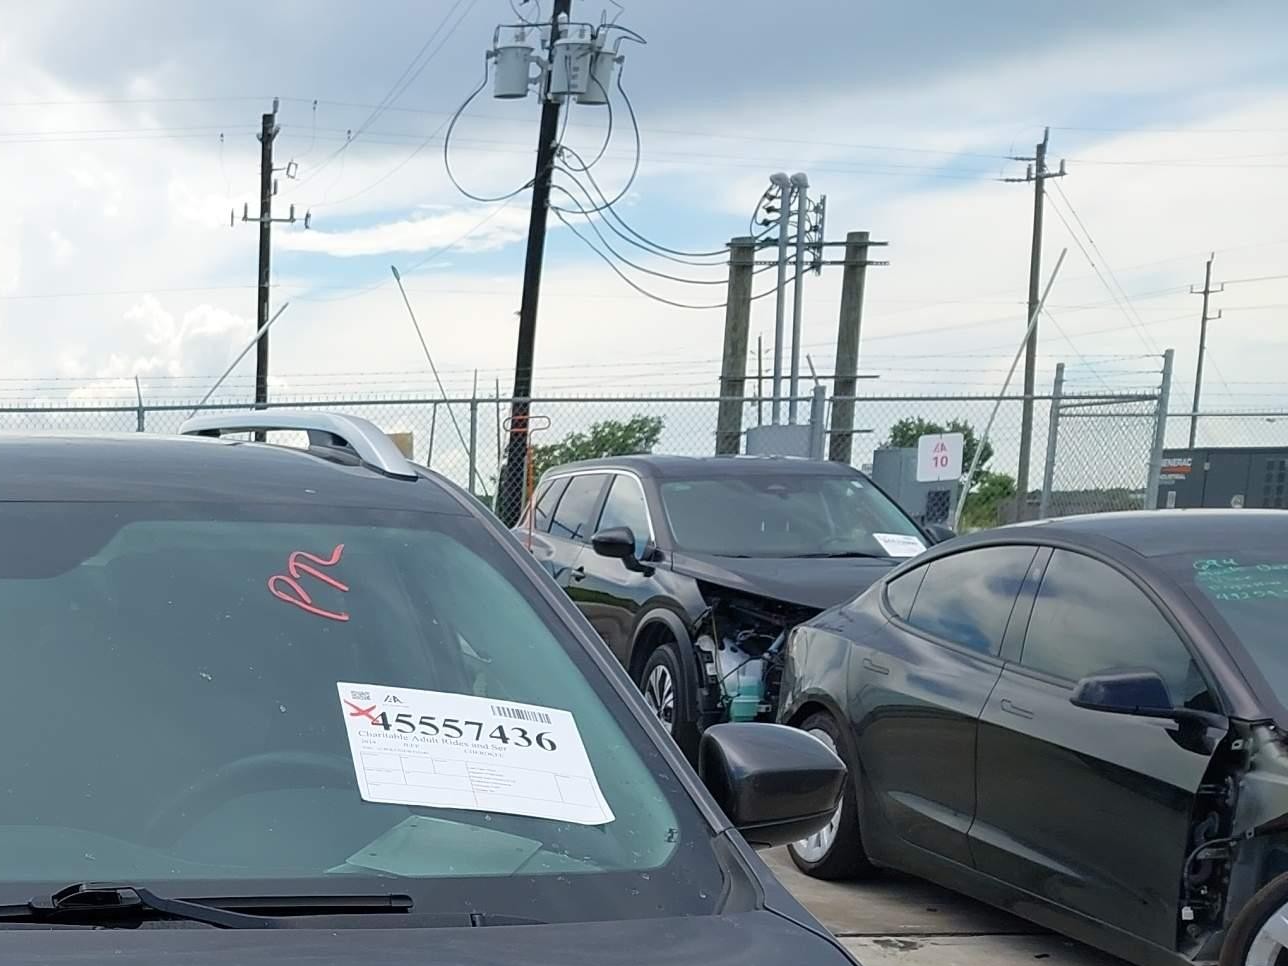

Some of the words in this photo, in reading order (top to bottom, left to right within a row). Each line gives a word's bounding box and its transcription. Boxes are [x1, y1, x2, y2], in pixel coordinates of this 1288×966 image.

[932, 455, 949, 468] 10
[358, 730, 409, 741] Charitable
[411, 735, 440, 745] Adult
[441, 738, 469, 747] Rides
[471, 742, 489, 750] and
[370, 711, 558, 751] 45557436
